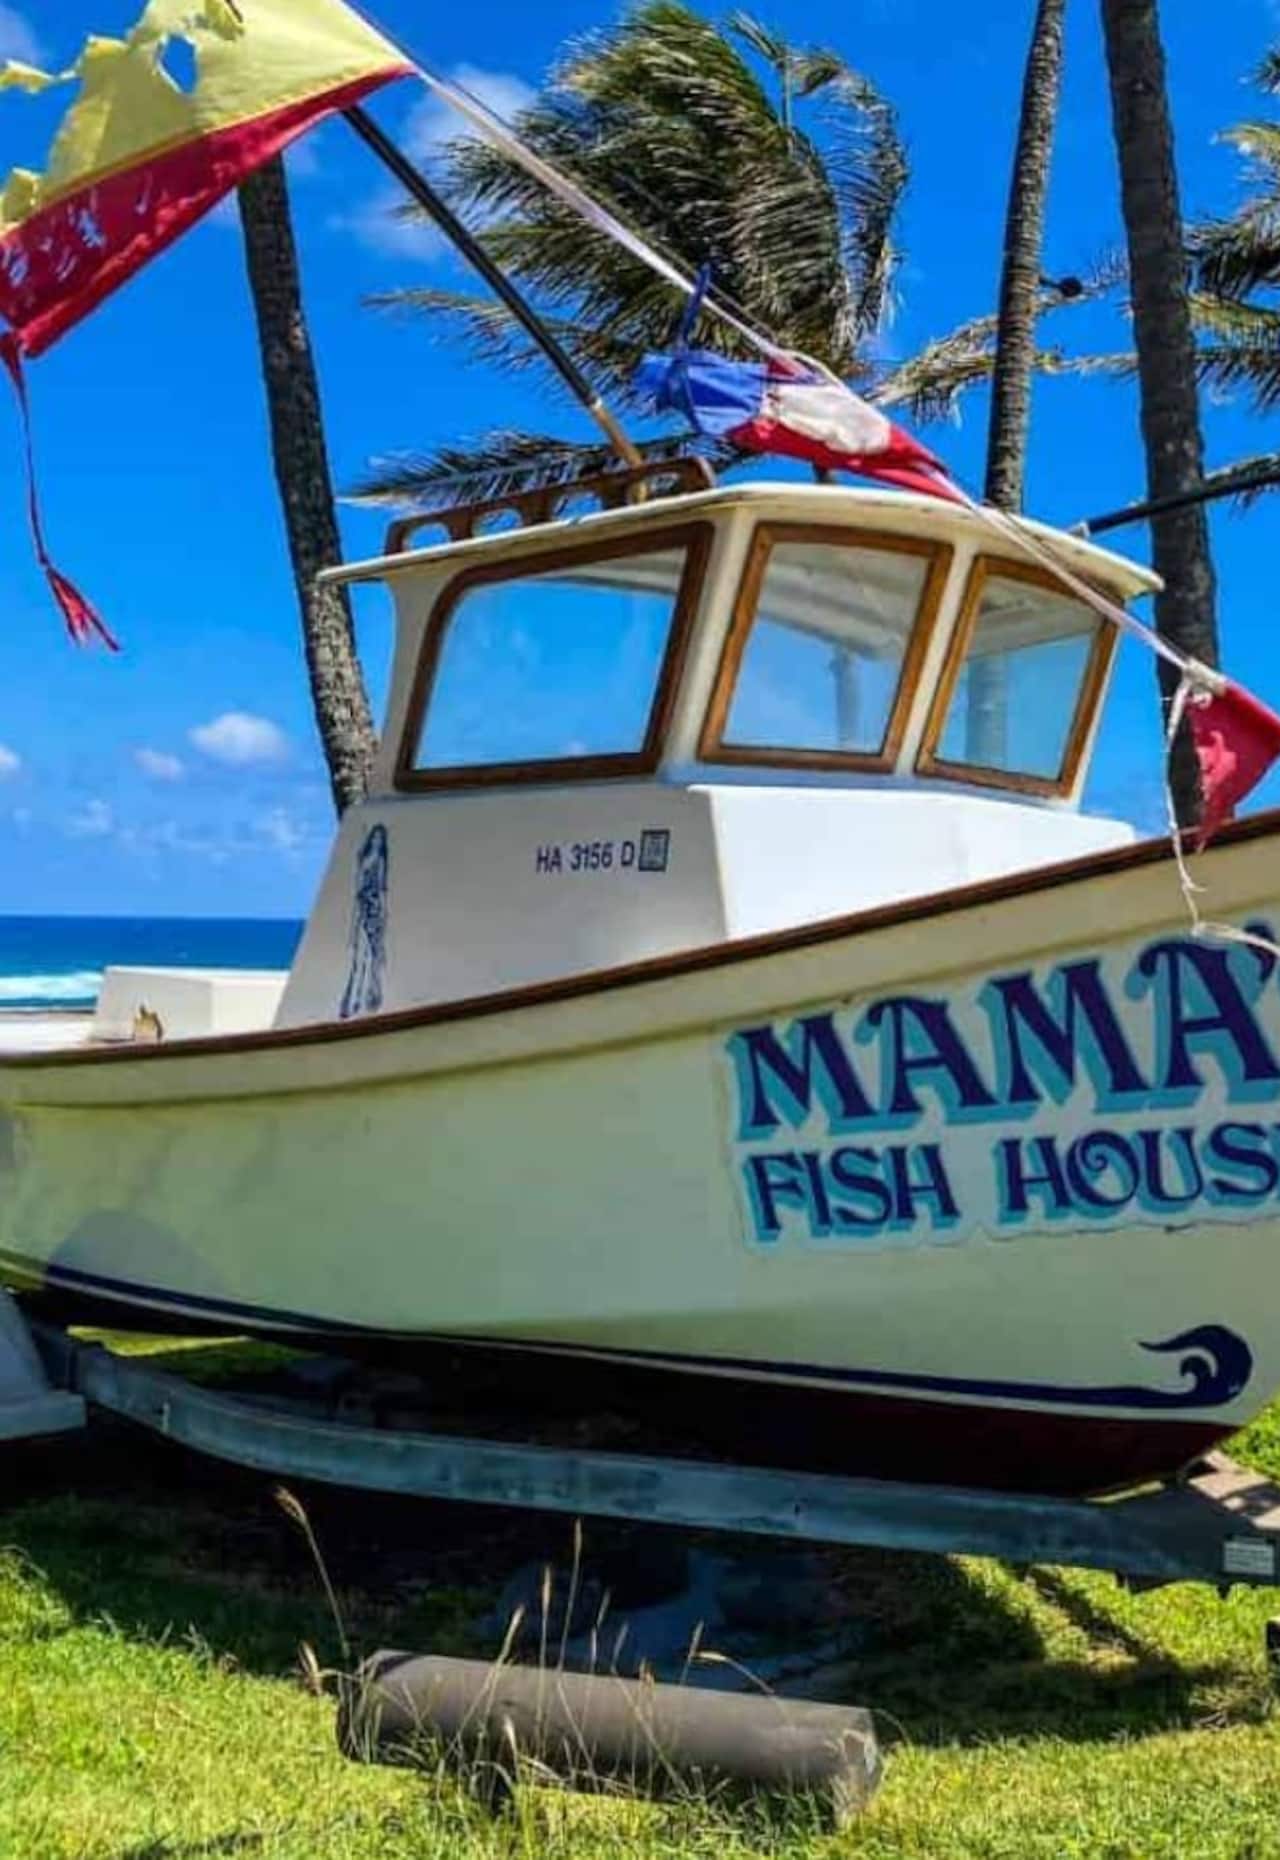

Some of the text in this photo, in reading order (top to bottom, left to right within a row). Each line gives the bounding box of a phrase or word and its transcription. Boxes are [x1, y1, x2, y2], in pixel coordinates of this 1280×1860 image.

[536, 847, 562, 873] HA
[570, 842, 613, 870] 3156
[621, 840, 635, 867] D
[746, 1142, 963, 1242] FISH
